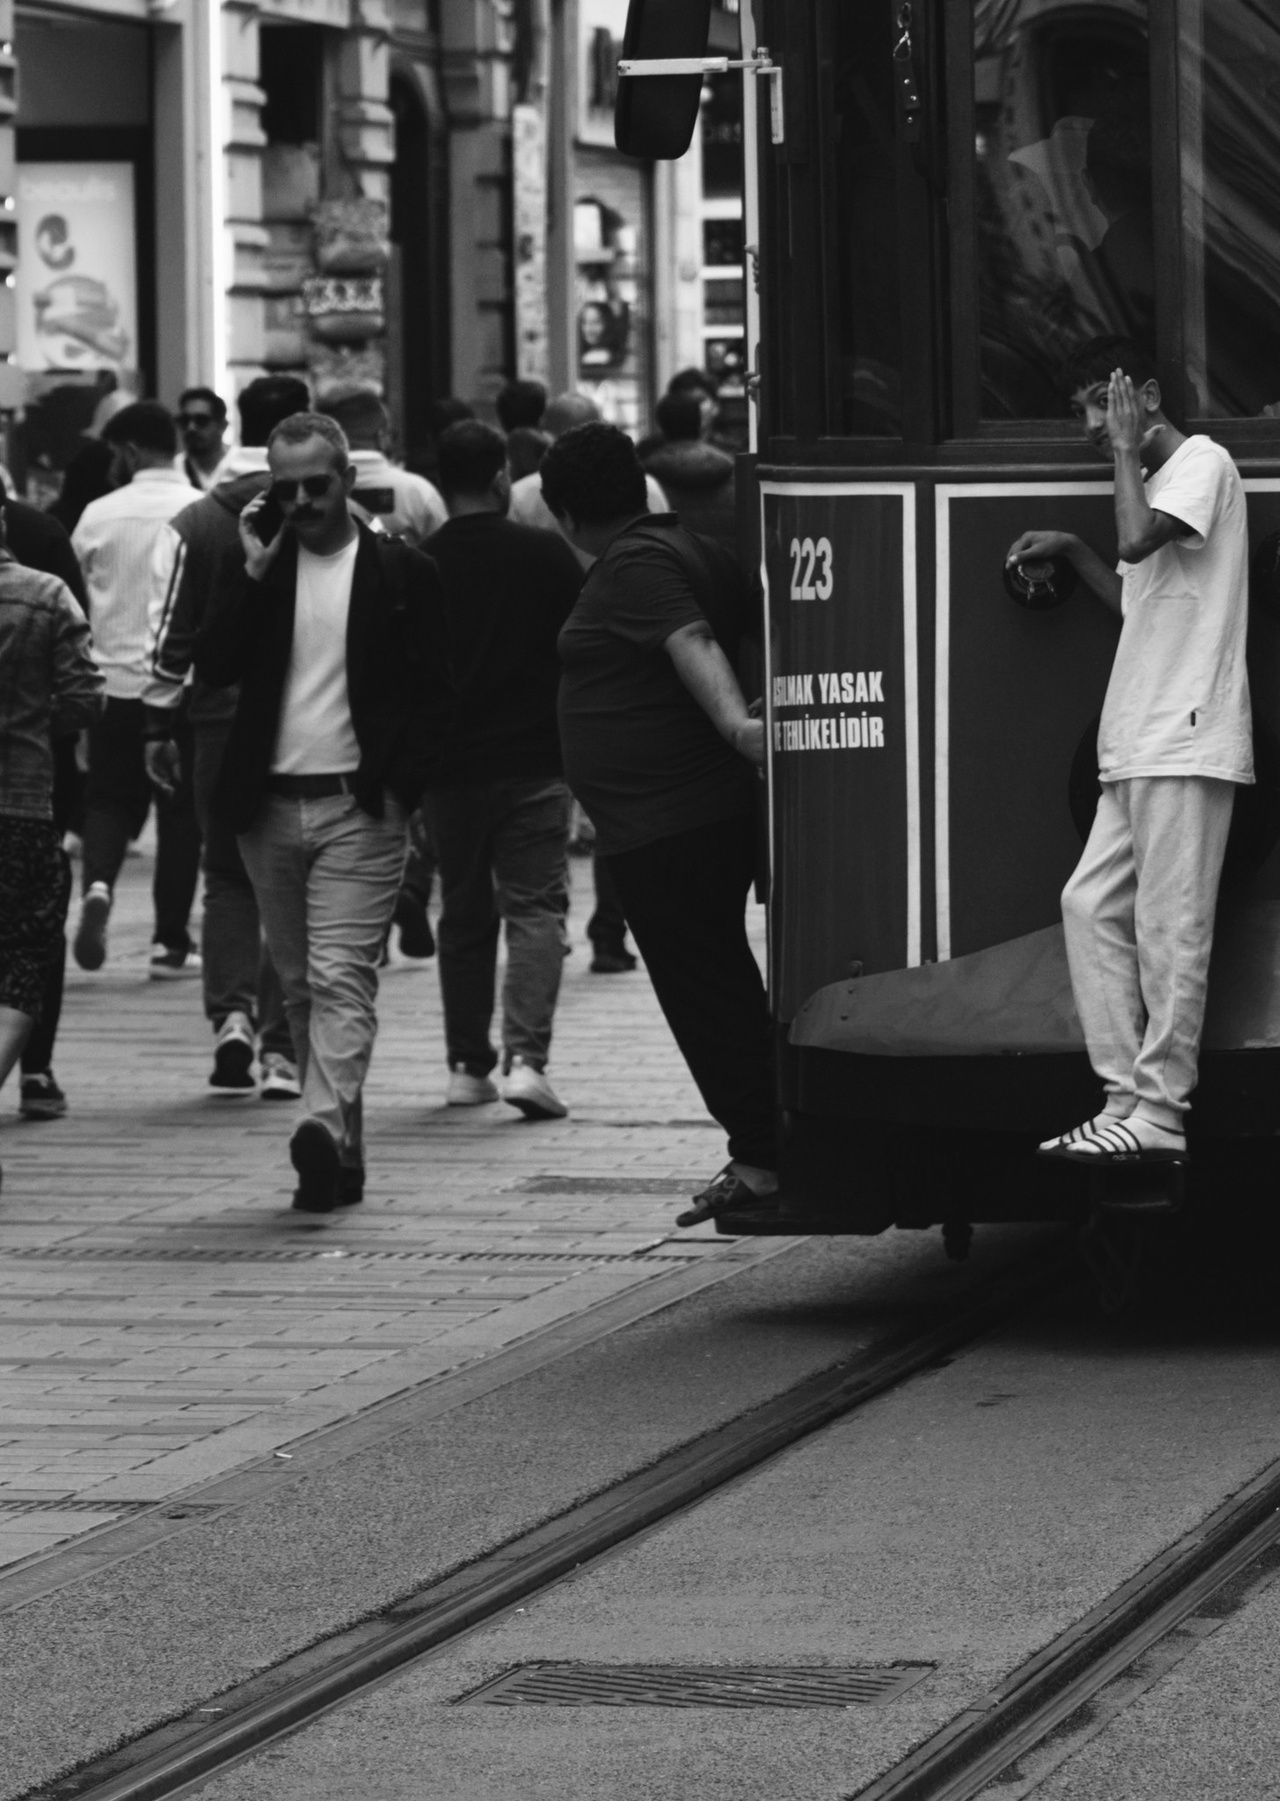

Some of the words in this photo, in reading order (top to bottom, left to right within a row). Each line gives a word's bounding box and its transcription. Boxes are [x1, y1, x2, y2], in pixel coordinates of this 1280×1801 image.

[789, 536, 834, 601] 223
[772, 674, 815, 707] ASILMAK
[818, 671, 885, 704] YASAK
[782, 711, 885, 751] TEHLİKELİDİR
